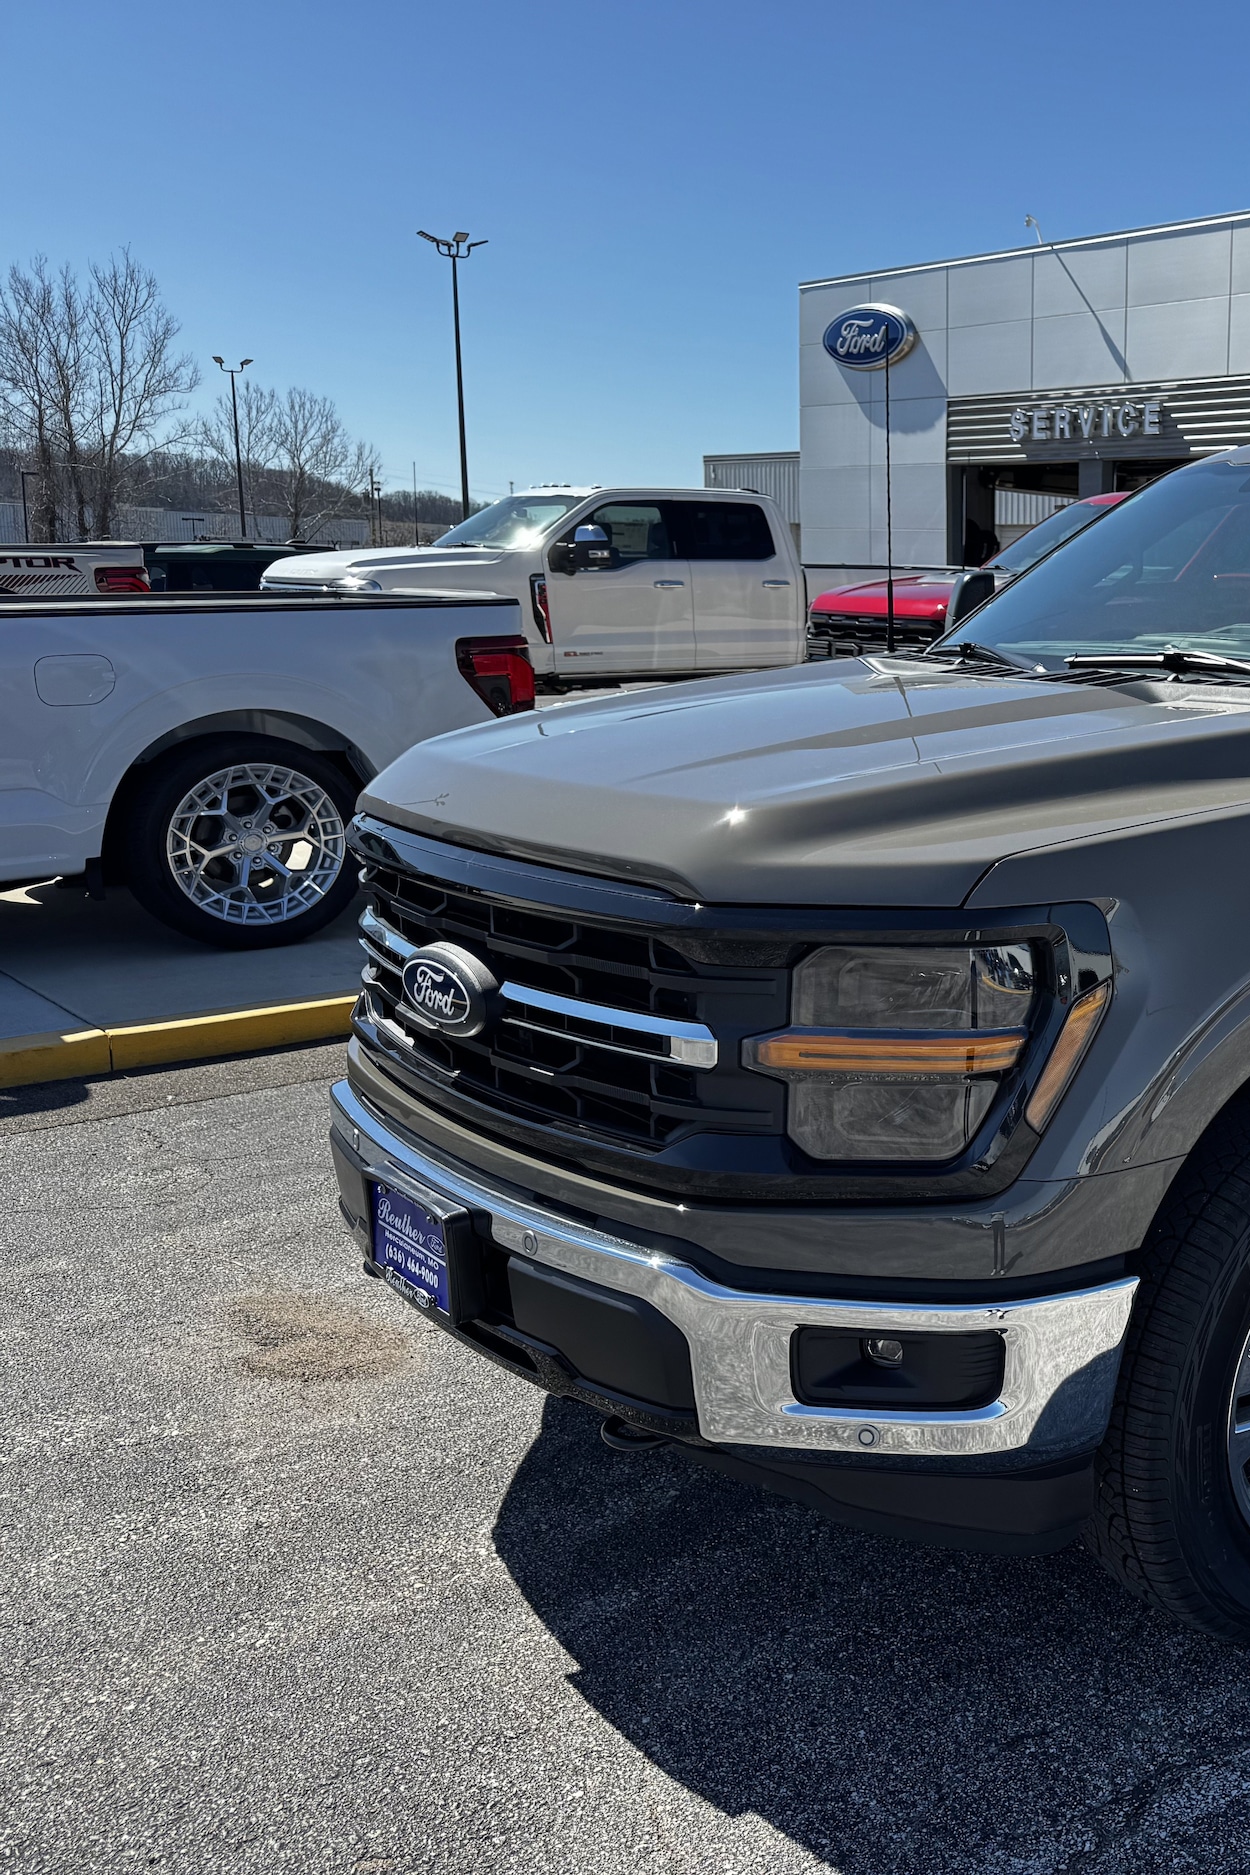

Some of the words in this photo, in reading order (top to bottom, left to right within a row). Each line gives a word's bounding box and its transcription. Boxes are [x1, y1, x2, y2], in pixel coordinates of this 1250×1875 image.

[836, 319, 886, 355] Ford
[1010, 401, 1162, 442] SERVICE
[413, 966, 455, 1016] Ford
[378, 1198, 426, 1245] Reuther
[385, 1243, 405, 1269] (636)
[407, 1257, 439, 1289] 464-9000
[427, 1258, 439, 1271] MO
